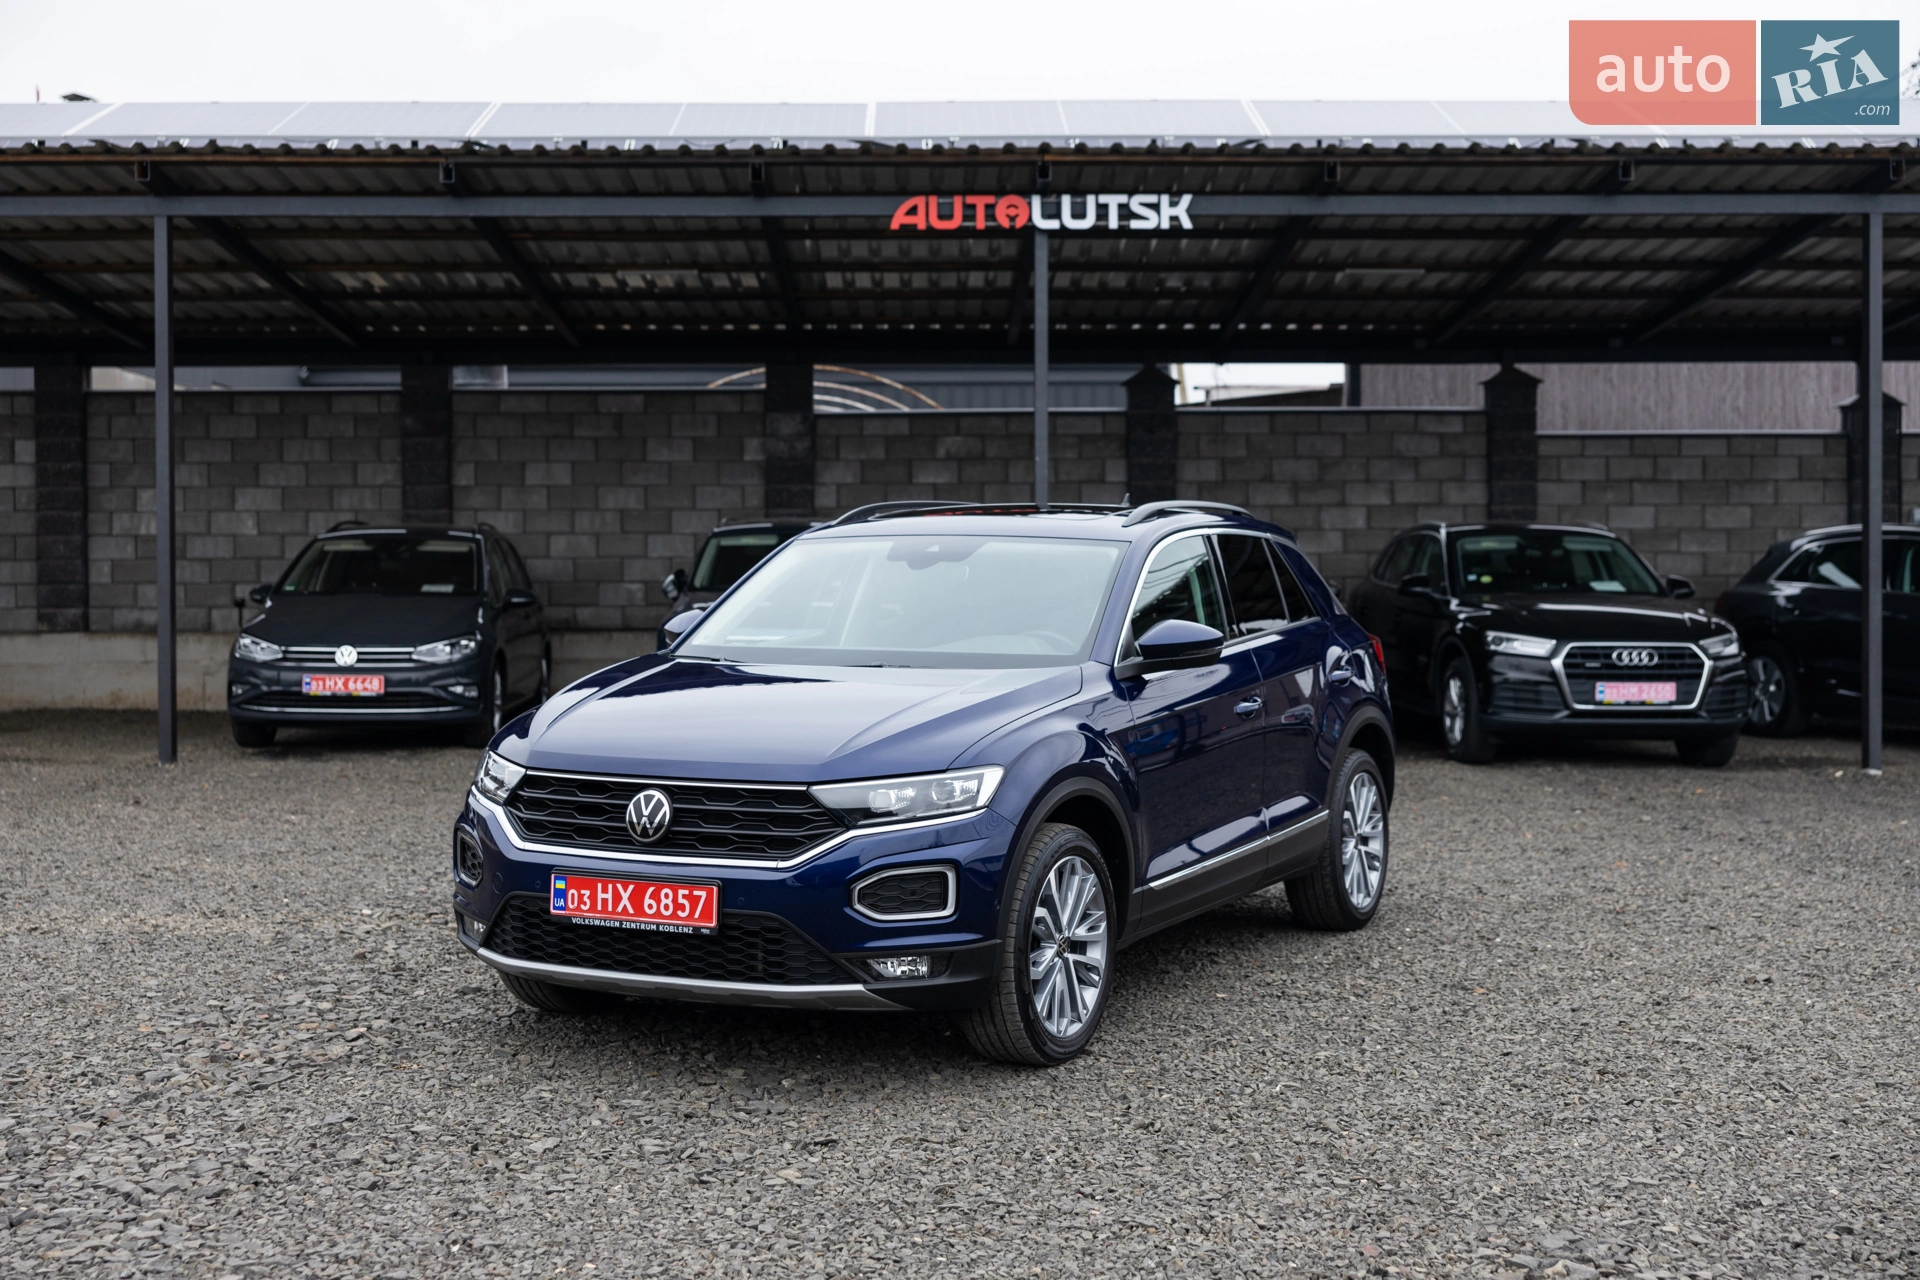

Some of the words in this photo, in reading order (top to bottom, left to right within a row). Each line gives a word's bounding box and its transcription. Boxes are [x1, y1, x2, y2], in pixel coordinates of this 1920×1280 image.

[325, 677, 346, 692] HX
[626, 789, 670, 841] VW
[554, 897, 565, 907] UA
[567, 888, 591, 911] 03
[597, 882, 635, 914] HX
[643, 886, 707, 919] 6857
[571, 916, 620, 928] VOLKSWAGEN
[622, 921, 657, 931] ZENTRUM
[659, 924, 694, 934] KOBLENZ
